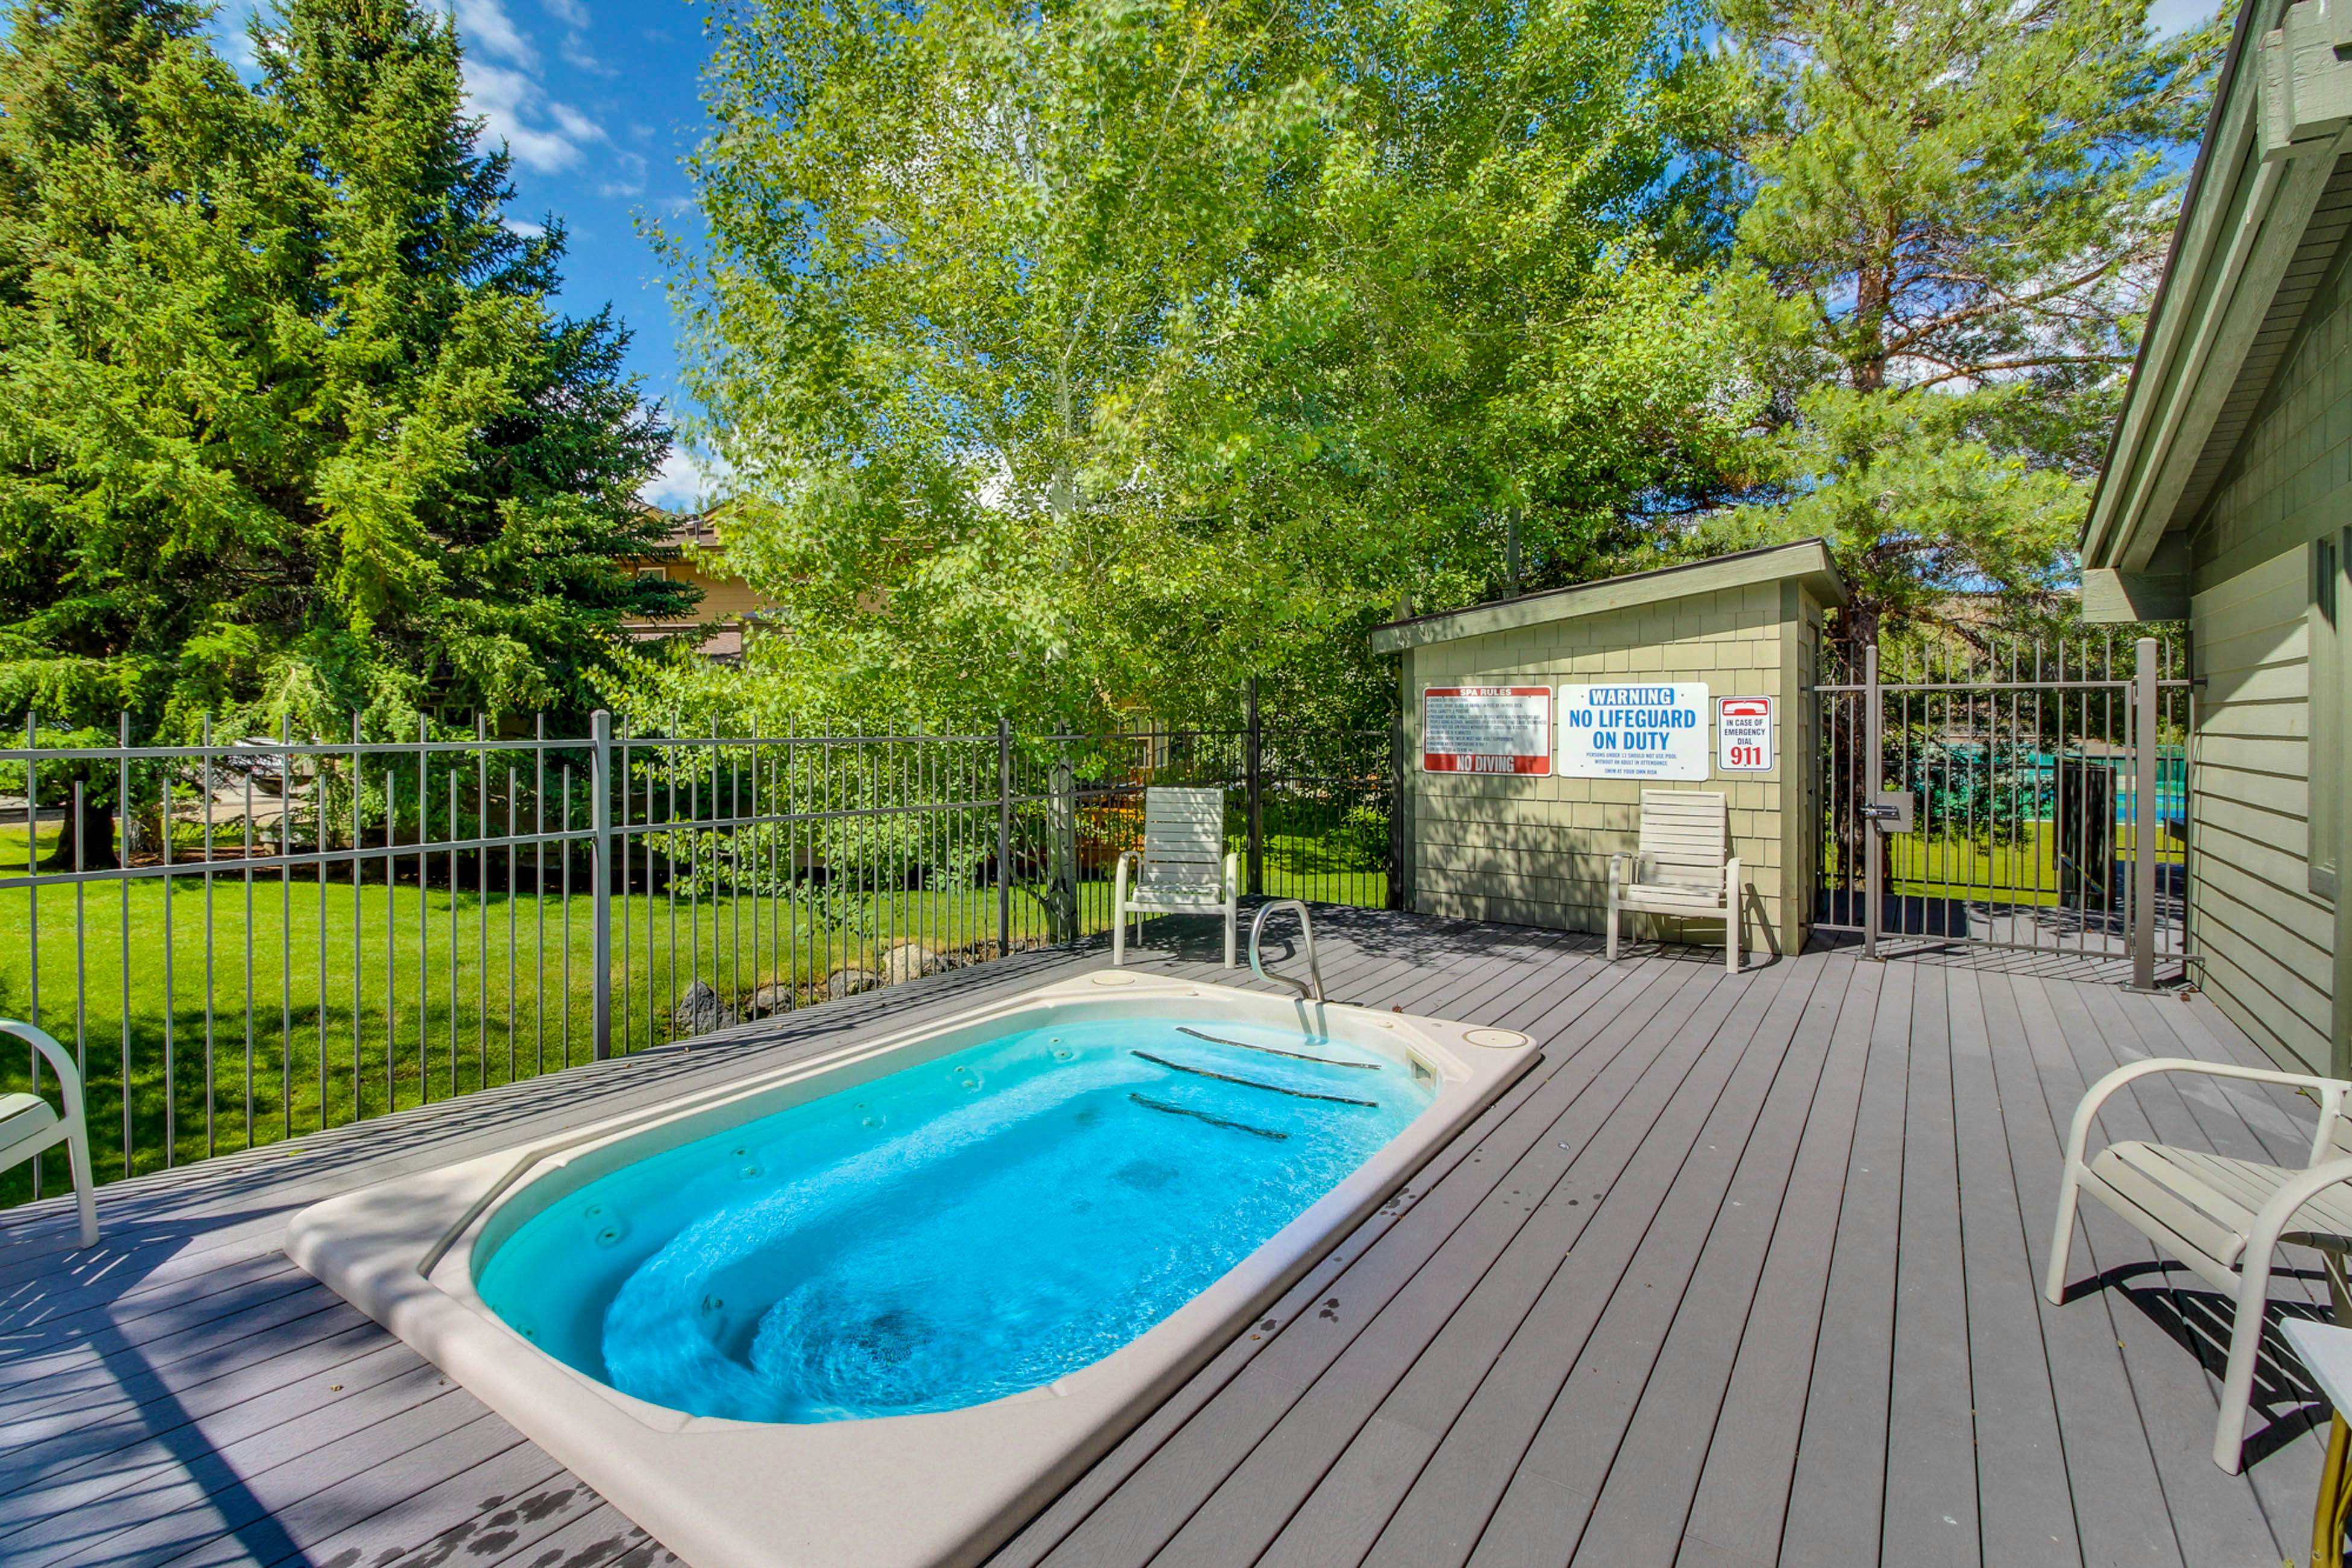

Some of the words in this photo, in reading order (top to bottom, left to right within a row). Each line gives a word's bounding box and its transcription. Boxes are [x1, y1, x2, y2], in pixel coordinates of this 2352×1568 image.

[1590, 689, 1672, 704] WARNING
[1569, 709, 1593, 727] NO
[1599, 709, 1696, 729] LIFEGUARD
[1593, 732, 1616, 750] ON
[1623, 732, 1670, 750] DUTY
[1456, 756, 1472, 771] NO
[1475, 756, 1515, 773] DIVING
[1730, 747, 1760, 765] 911
